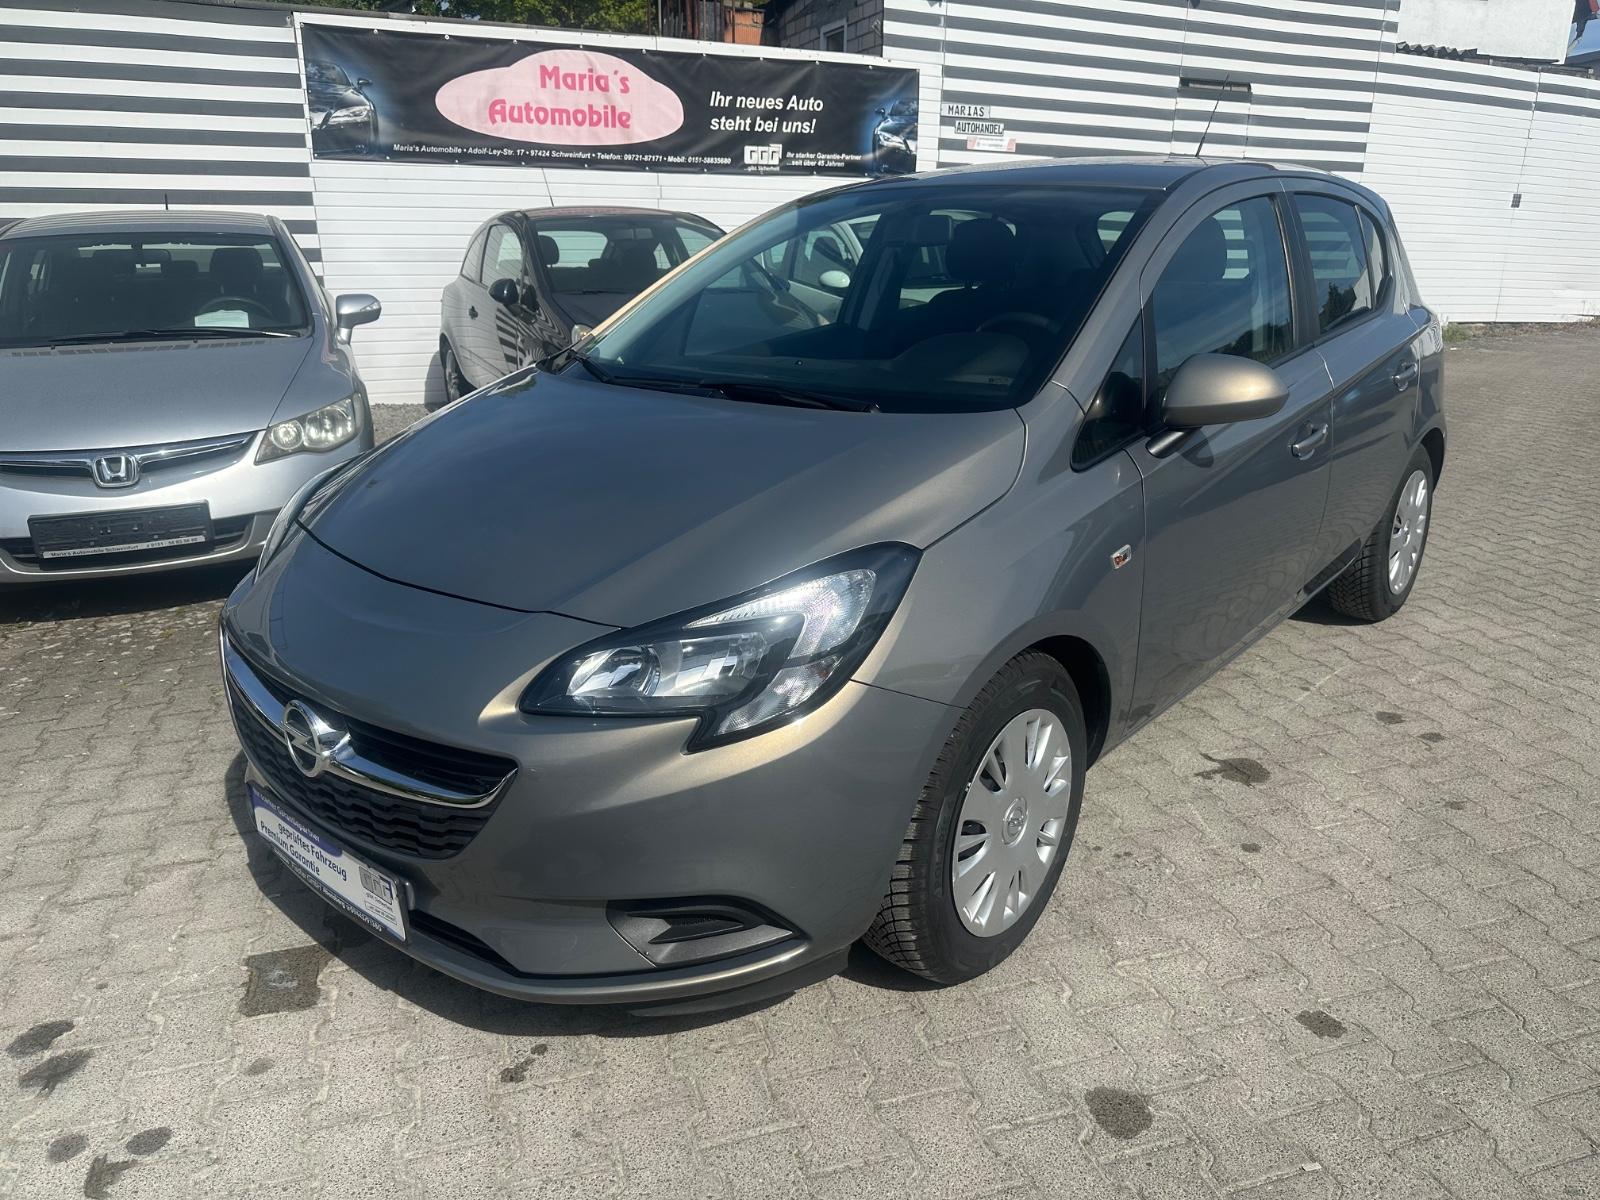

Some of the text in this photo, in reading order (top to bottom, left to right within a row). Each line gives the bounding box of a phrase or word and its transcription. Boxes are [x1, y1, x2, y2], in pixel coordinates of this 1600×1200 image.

[710, 91, 824, 112] Ihr neues Auto
[947, 105, 985, 117] MARIAS
[488, 98, 631, 129] Automobile
[710, 115, 816, 134] steht bei uns!
[957, 122, 1003, 135] AUTOHANDEL
[393, 143, 420, 152] Maria's
[421, 145, 462, 154] Automobile
[468, 147, 515, 157] Adolf-Ley-Str.
[530, 149, 550, 157] 97424
[551, 150, 591, 159] Schweinfurt
[597, 152, 623, 161] Telefon:
[667, 155, 687, 163] Mobil:
[817, 152, 862, 161] Garantie-Partner
[73, 548, 104, 556] Automobile
[105, 545, 139, 553] Schweinfurt
[260, 820, 289, 851] Premium
[289, 844, 320, 876] Garantie
[277, 823, 310, 853] geprüftes
[311, 845, 347, 881] Fahrzeug
